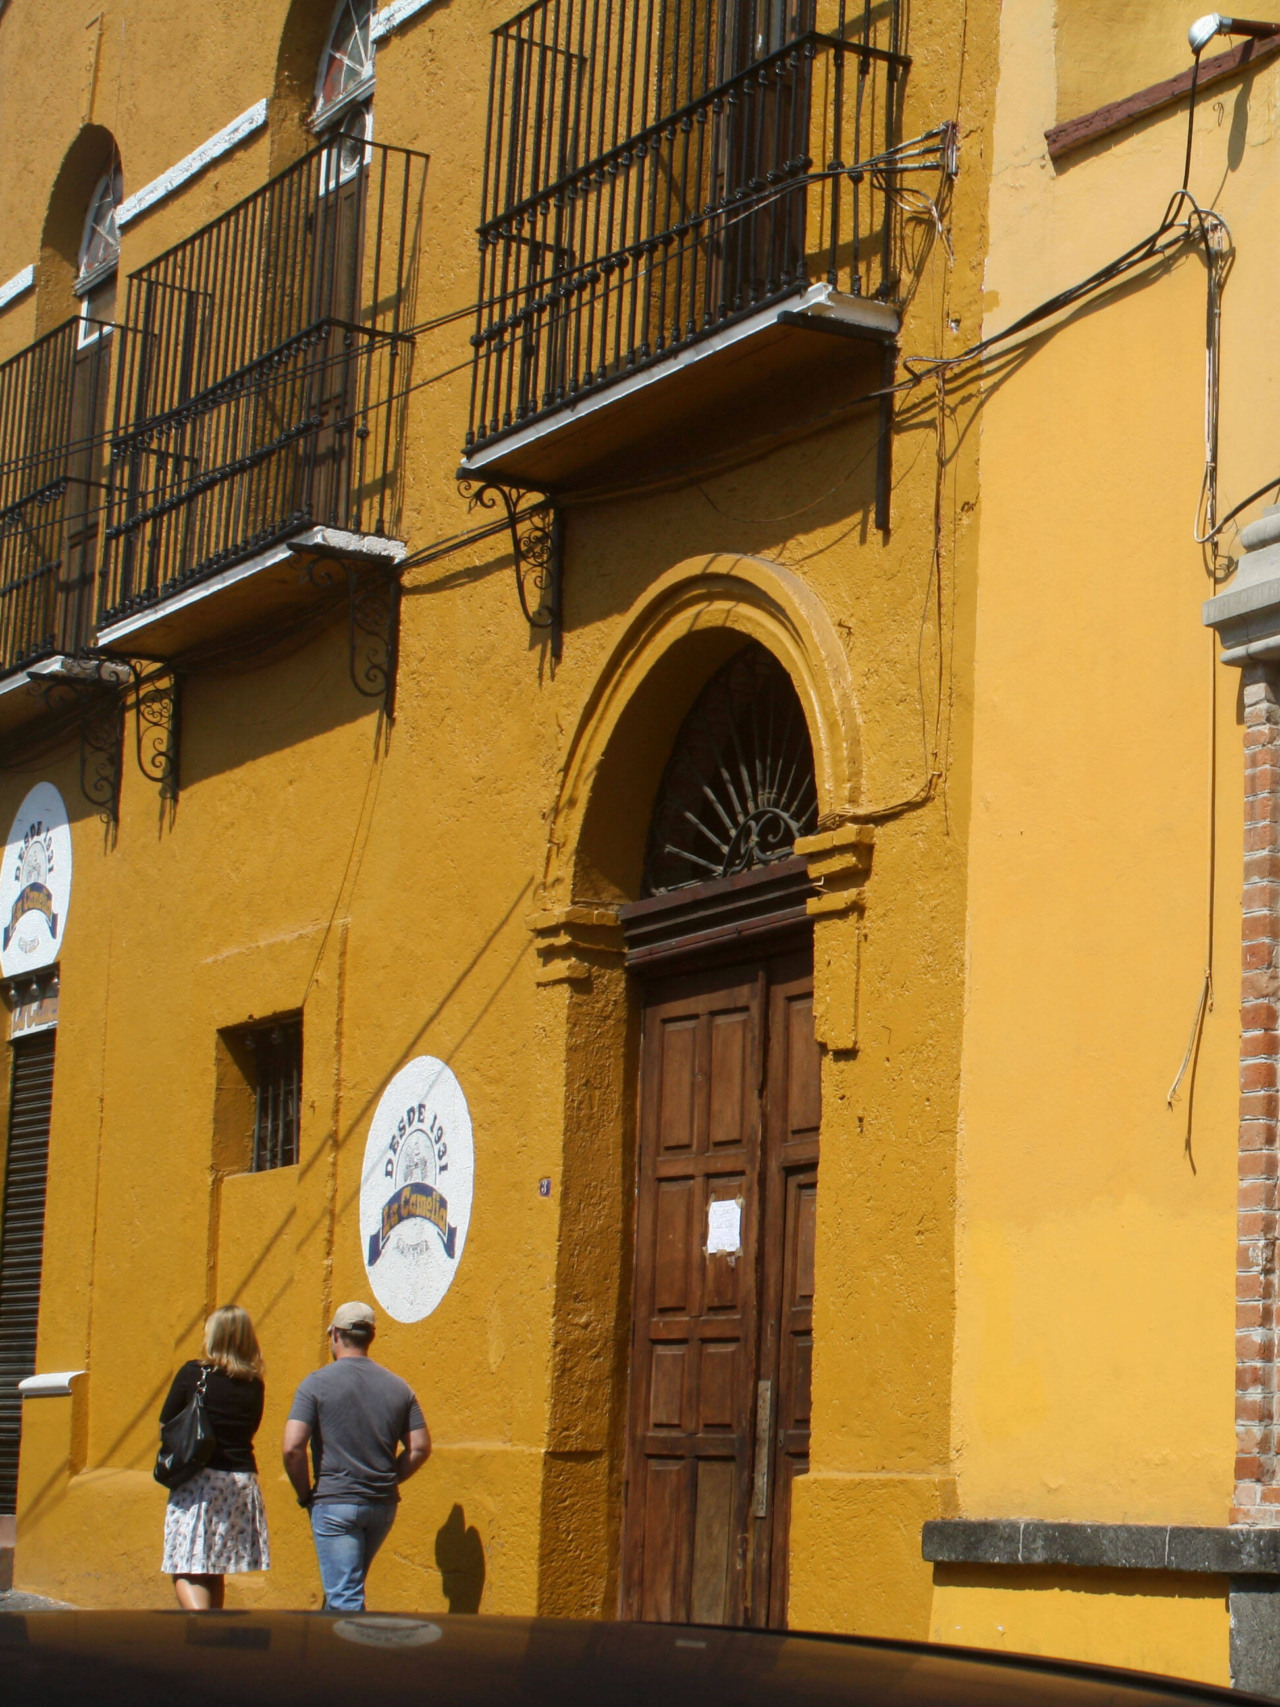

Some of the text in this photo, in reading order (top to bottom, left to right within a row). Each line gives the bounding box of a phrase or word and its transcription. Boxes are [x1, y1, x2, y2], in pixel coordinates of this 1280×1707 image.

[15, 821, 43, 881] DESDE
[385, 1104, 449, 1179] DESDE 1931
[382, 1187, 447, 1236] La Camelia
